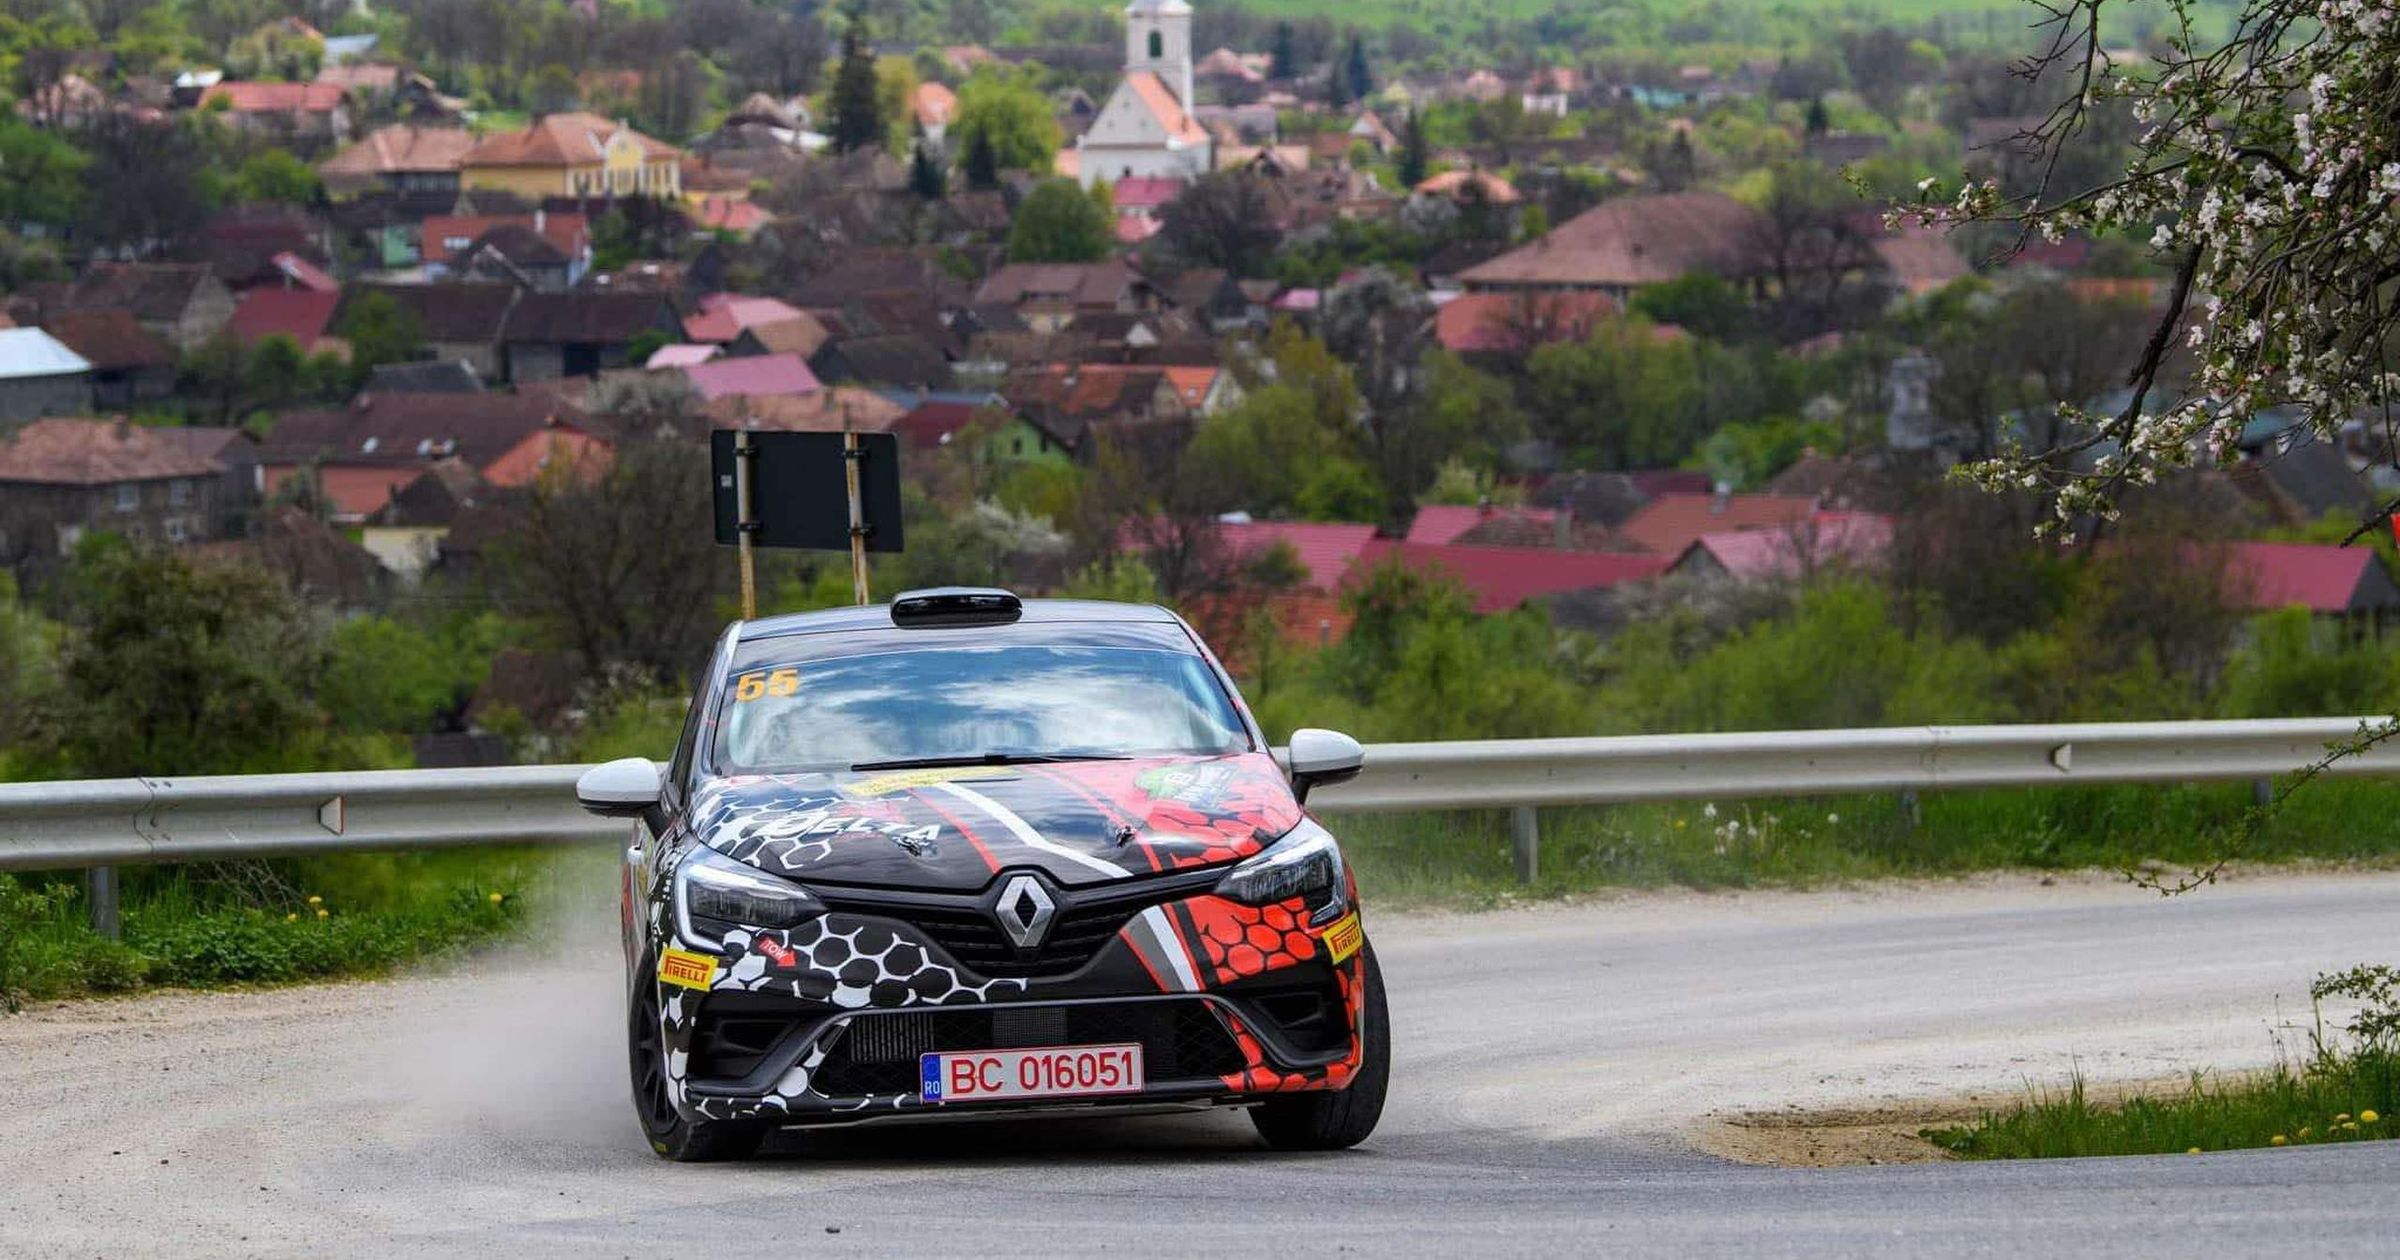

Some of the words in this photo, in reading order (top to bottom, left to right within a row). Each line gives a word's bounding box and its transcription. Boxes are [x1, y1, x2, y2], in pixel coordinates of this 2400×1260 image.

[736, 669, 799, 703] 55
[759, 938, 786, 960] TOW
[664, 955, 710, 984] PIRELLI
[924, 1080, 940, 1095] RO
[951, 1058, 1003, 1095] BC
[1019, 1051, 1133, 1090] 016051
